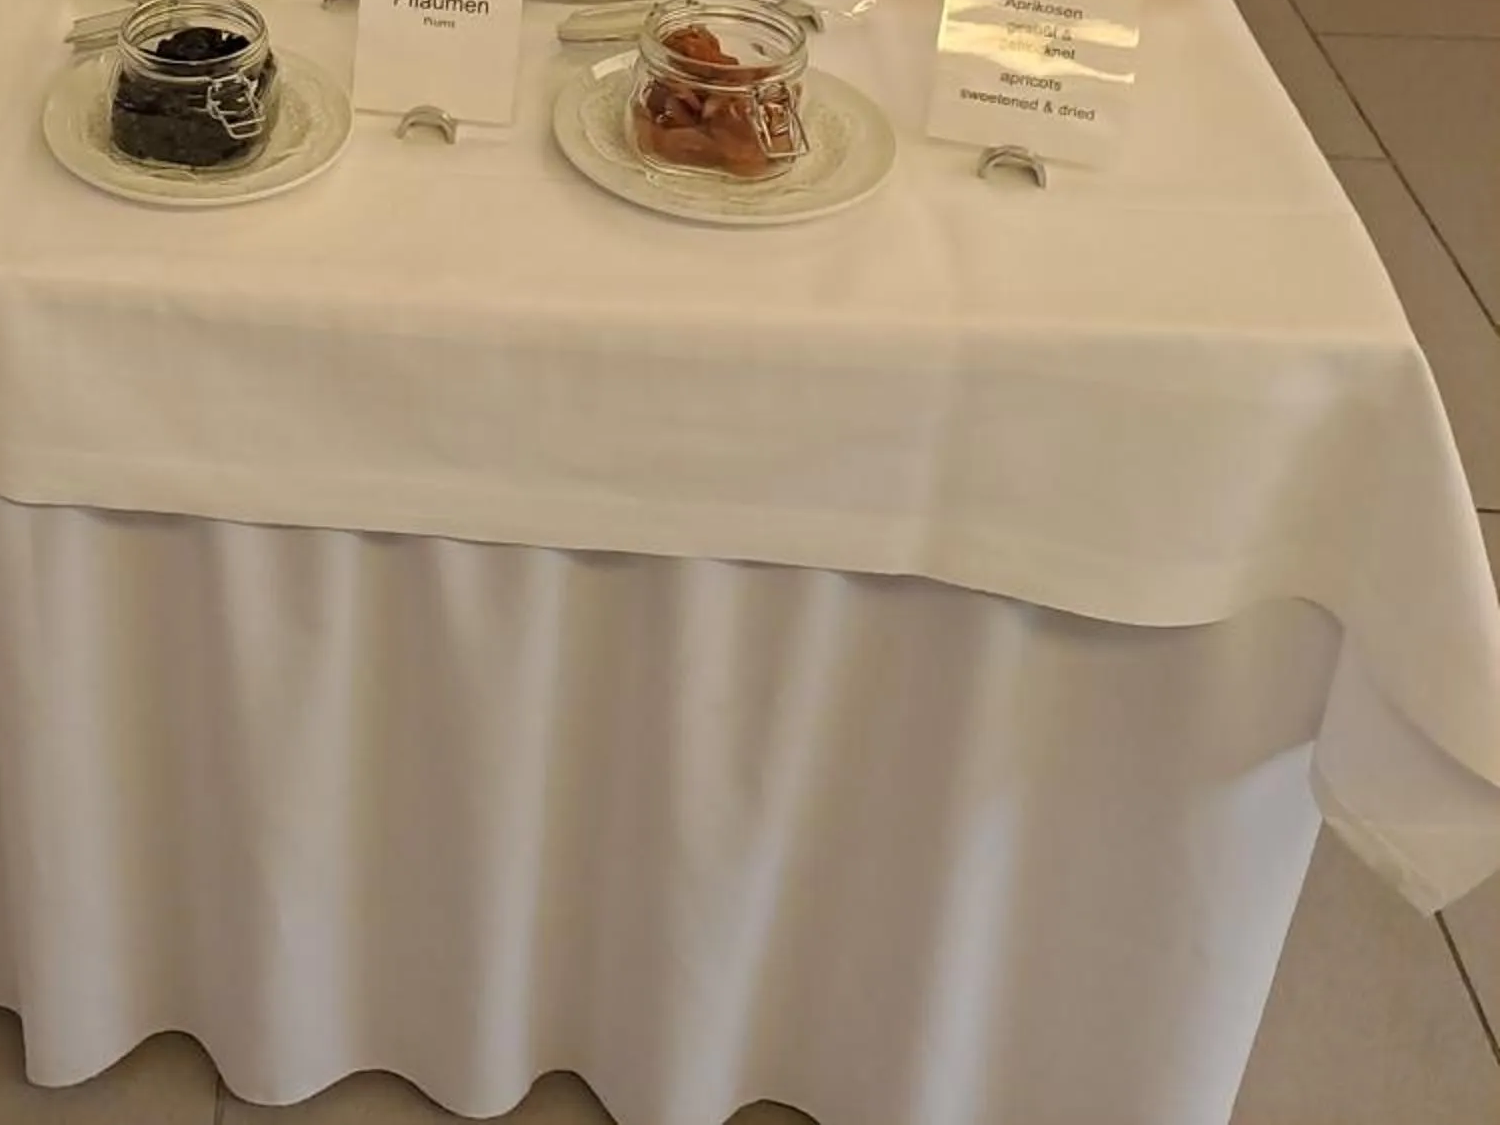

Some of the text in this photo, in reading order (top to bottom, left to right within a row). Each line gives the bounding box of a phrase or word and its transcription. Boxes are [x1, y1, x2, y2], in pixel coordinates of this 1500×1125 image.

[1000, 71, 1062, 92] apricots
[960, 87, 1039, 112] sweetened
[1058, 103, 1096, 122] dried
